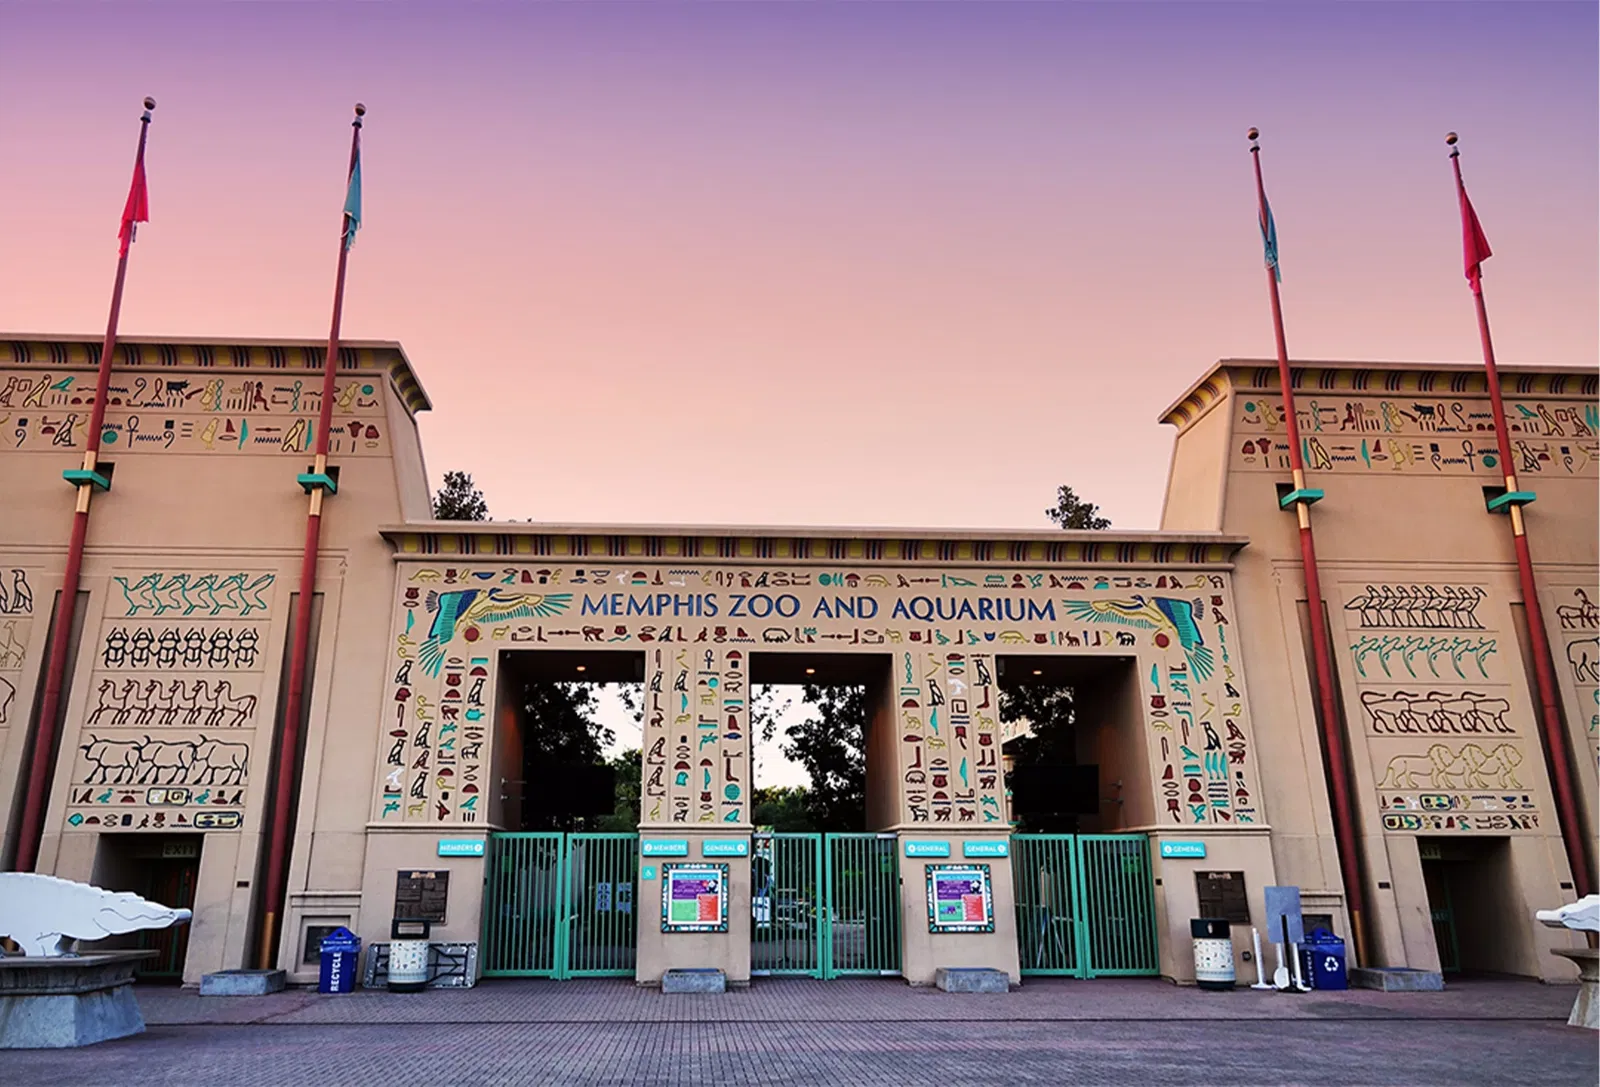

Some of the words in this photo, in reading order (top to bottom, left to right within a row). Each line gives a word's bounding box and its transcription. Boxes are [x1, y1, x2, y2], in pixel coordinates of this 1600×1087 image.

[580, 593, 719, 617] MEMPHIS
[727, 594, 801, 618] ZOO
[812, 596, 879, 619] AND
[891, 596, 1056, 622] AQUARIUM
[439, 843, 473, 852] MEMBERS
[653, 843, 686, 852] MEMBERS
[705, 844, 735, 852] GENERAL
[916, 844, 947, 852] GENERAL
[966, 844, 996, 852] GENERAL
[1173, 844, 1203, 853] GENERAL
[330, 951, 342, 992] RECYCLE
